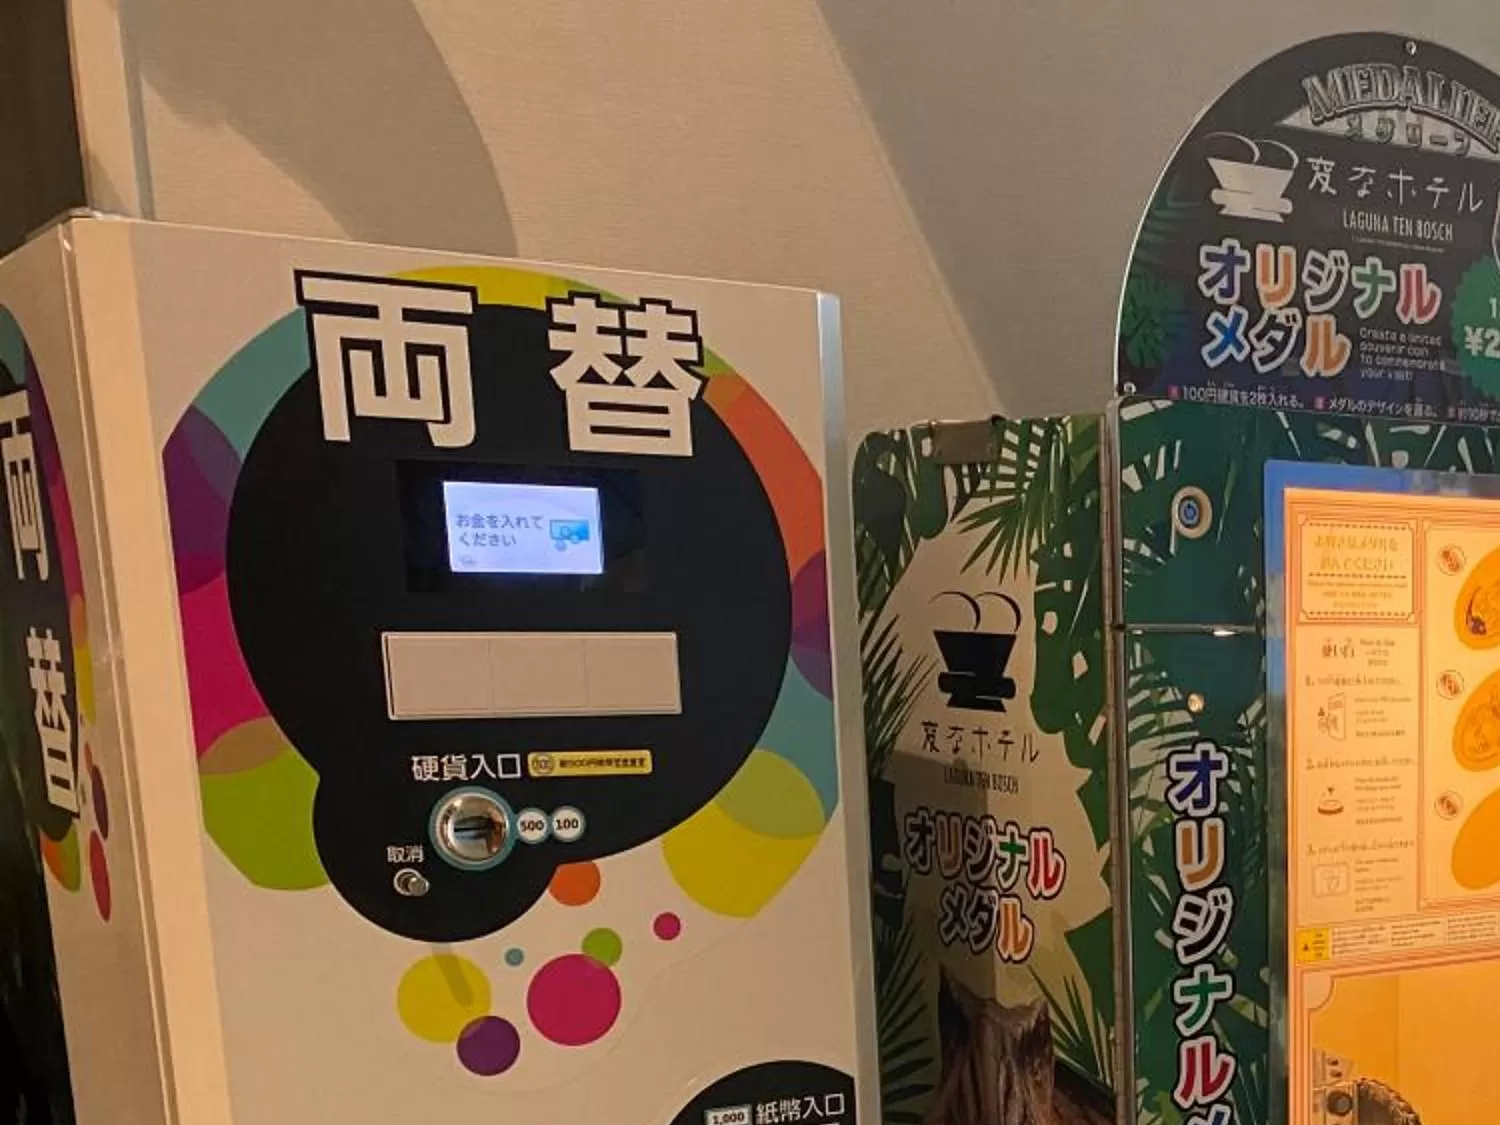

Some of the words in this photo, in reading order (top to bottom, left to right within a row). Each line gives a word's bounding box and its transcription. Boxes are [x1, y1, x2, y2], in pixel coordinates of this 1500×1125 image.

[1305, 155, 1484, 213] 変なホテル
[1342, 208, 1389, 234] LAGUNA
[1392, 216, 1414, 236] TEN
[1416, 219, 1454, 241] BOSCH
[1198, 238, 1441, 326] オリジナル
[1201, 307, 1353, 379] メダル
[294, 268, 706, 458] 両替
[456, 513, 545, 531] お金を入れて
[459, 532, 517, 548] ください
[920, 719, 1040, 764] 変なホテル
[411, 752, 522, 782] 硬貨入口
[519, 818, 545, 833] 500
[554, 818, 580, 831] 100
[386, 843, 425, 864] 取消
[904, 806, 1068, 901] オリジナル
[938, 881, 1035, 965] メダル
[755, 1092, 846, 1125] 紙幣入口
